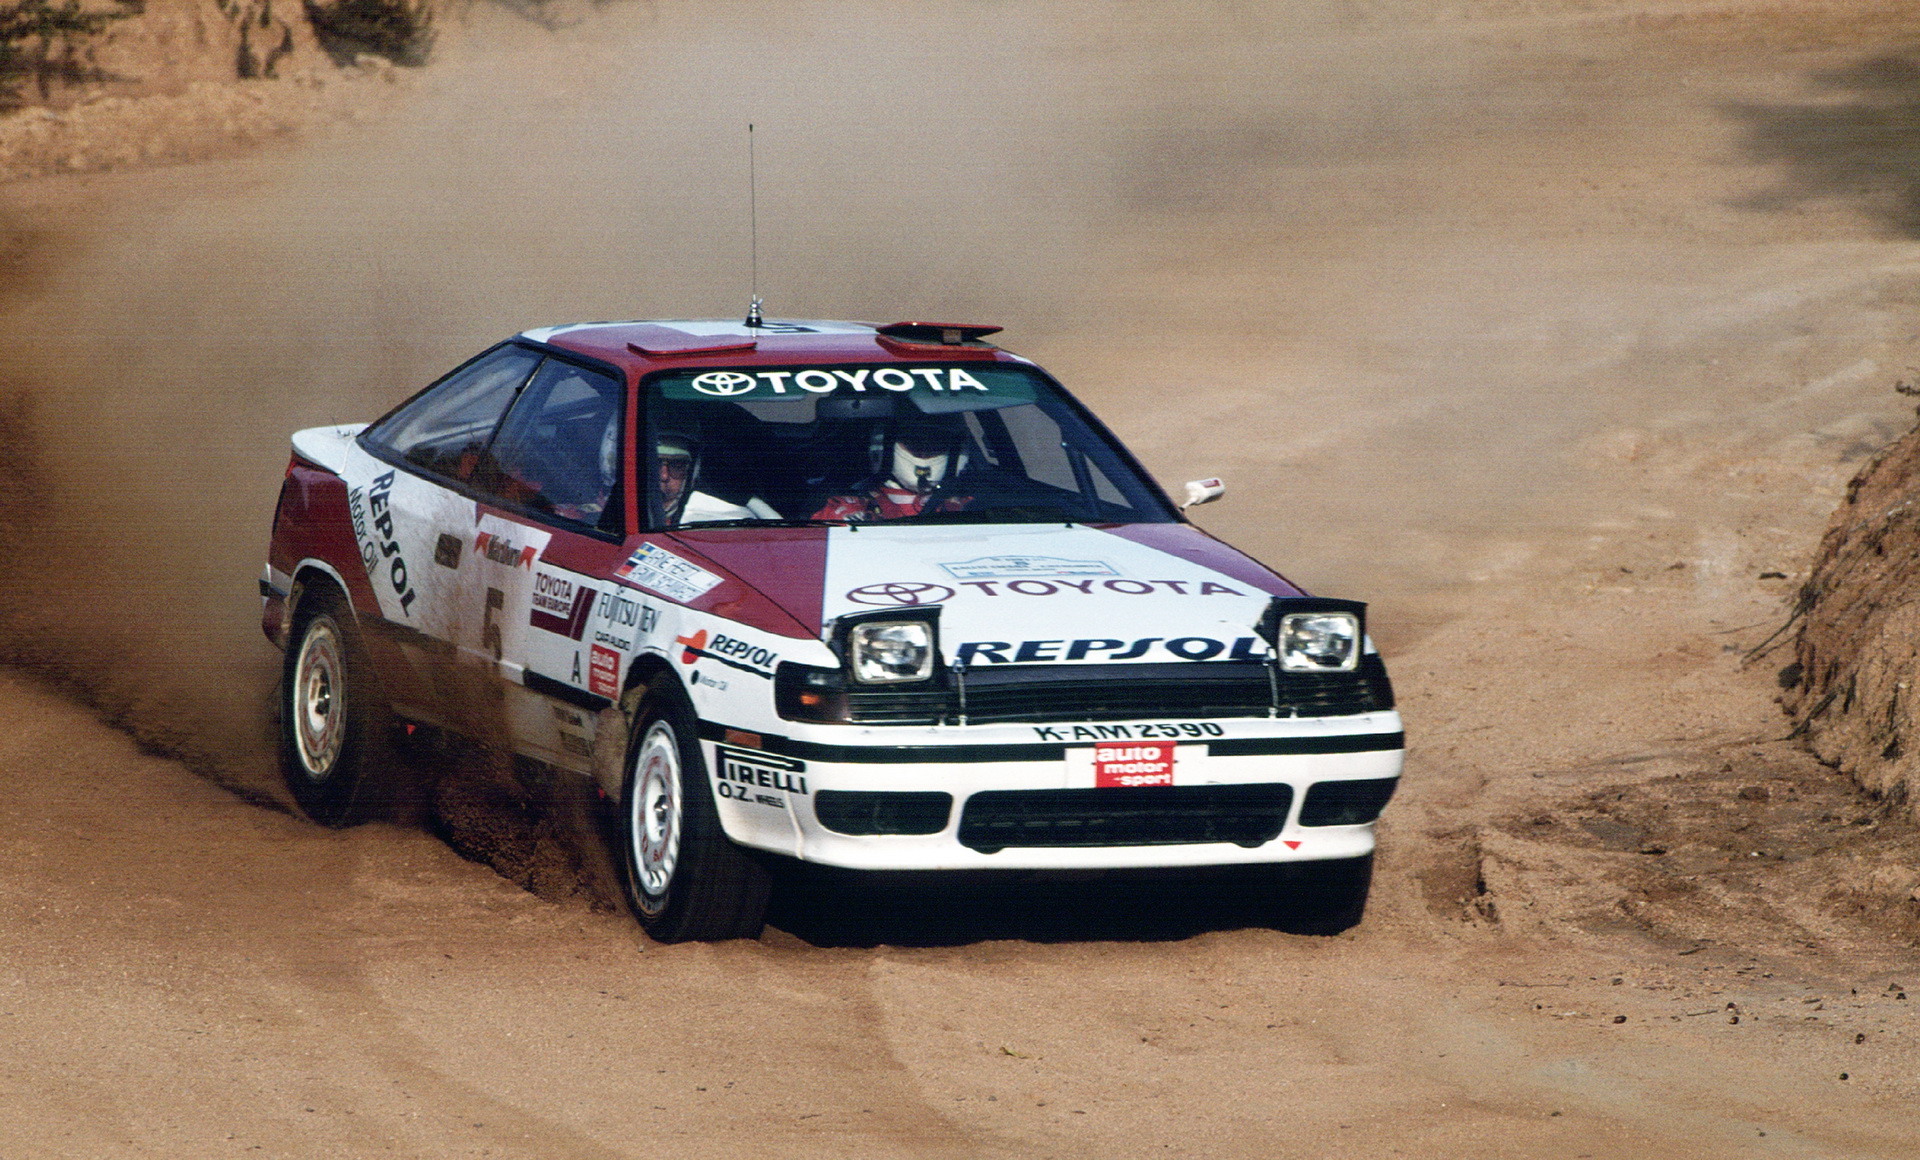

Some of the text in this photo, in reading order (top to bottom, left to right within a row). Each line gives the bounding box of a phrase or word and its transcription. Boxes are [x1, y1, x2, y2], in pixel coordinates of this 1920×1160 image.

[756, 368, 989, 393] TOYOTA
[350, 485, 367, 542] Motor
[369, 470, 416, 618] REPSOL
[534, 572, 572, 600] TOYOTA
[959, 580, 1249, 597] TOYOTA
[482, 587, 505, 661] 5
[598, 592, 662, 634] FUJITSU TEN
[591, 651, 615, 670] auto
[708, 633, 779, 668] REPSOL
[956, 636, 1267, 664] REPSOL
[571, 650, 582, 684] A
[1033, 722, 1225, 741] K-AM 2590
[1097, 747, 1162, 762] auto
[1104, 762, 1169, 774] motor
[715, 744, 808, 795] PIRELLI
